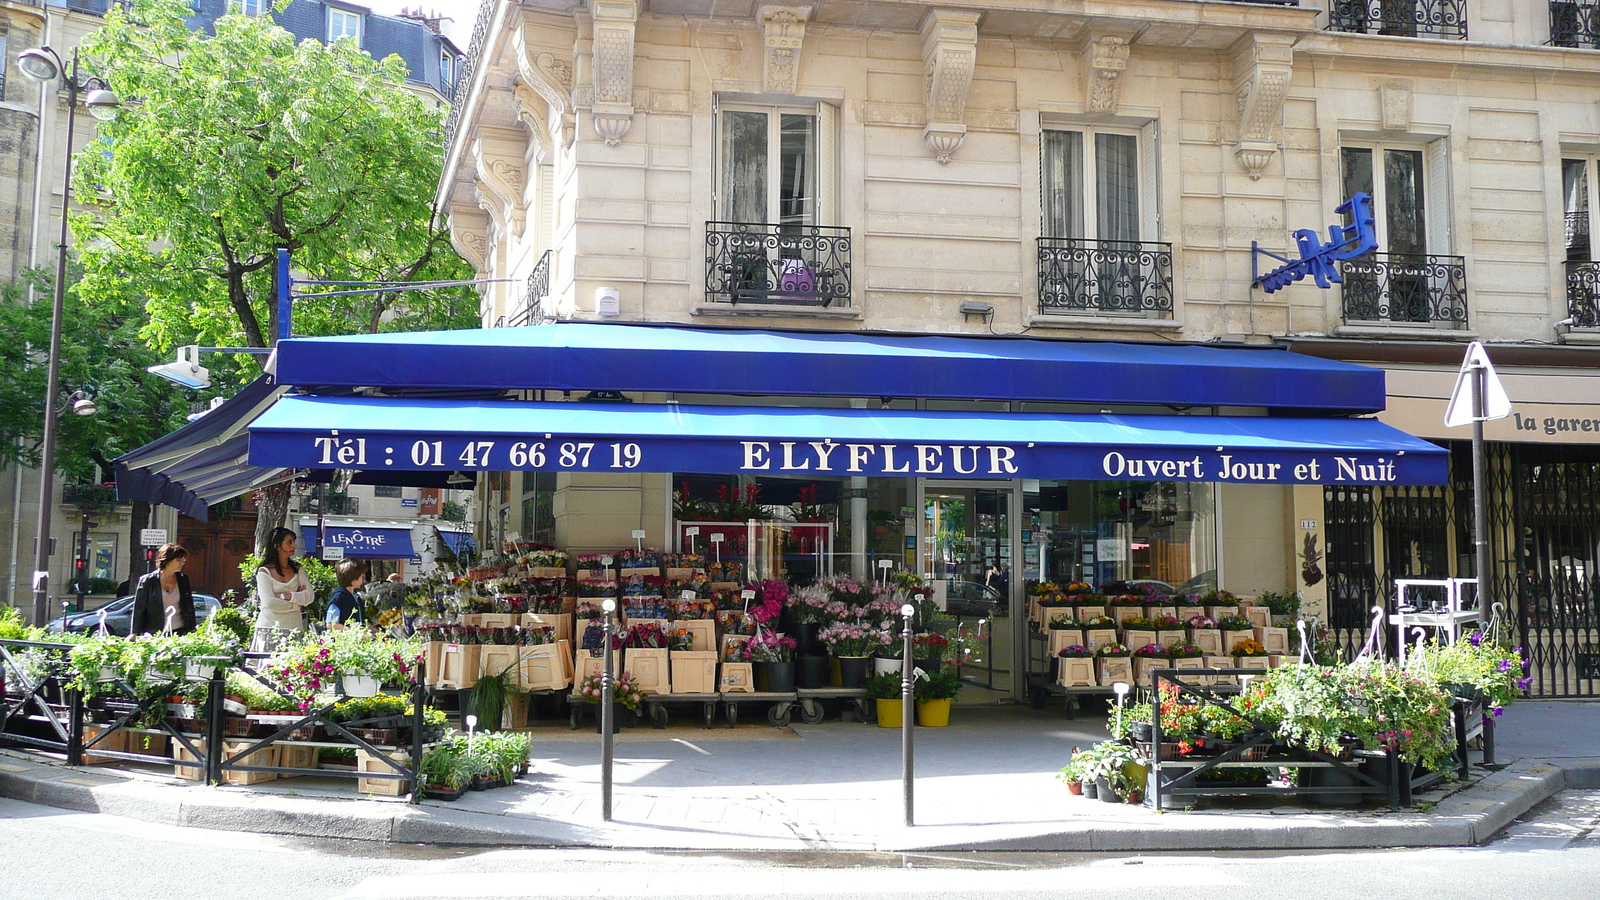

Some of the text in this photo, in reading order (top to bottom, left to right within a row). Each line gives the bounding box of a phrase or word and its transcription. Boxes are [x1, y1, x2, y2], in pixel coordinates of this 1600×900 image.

[1513, 412, 1537, 430] la
[315, 437, 367, 465] Tél
[411, 440, 445, 467] 01
[459, 441, 494, 467] 47
[509, 442, 546, 468] 66
[559, 443, 594, 468] 87
[610, 443, 641, 469] 19
[740, 441, 1019, 474] ELYFLEUR
[1102, 451, 1397, 482] Ouvert Jour et Nuit
[332, 530, 386, 546] LENÔTRE
